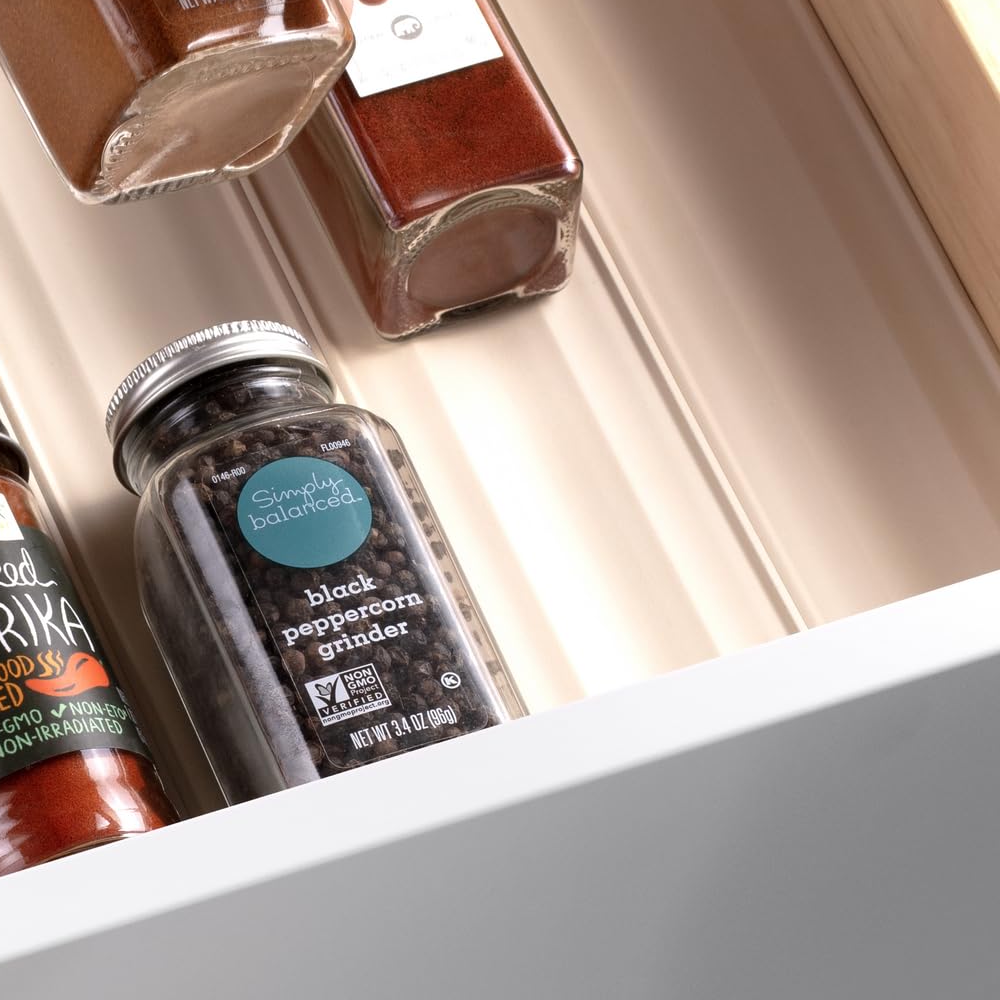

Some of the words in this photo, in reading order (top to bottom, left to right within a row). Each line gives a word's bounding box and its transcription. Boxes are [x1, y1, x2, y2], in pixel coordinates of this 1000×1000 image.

[320, 438, 351, 453] FL00946
[211, 466, 247, 484] 0146-R00
[251, 472, 344, 509] Simply
[304, 574, 377, 608] black
[281, 591, 424, 647] peppercorn
[317, 619, 410, 662] grinder
[344, 667, 373, 683] NON
[348, 676, 376, 690] GMO
[350, 684, 380, 697] Project
[321, 692, 384, 715] VERIFIED
[322, 699, 390, 724] nongmoproject.org
[350, 729, 374, 750] NET
[371, 722, 393, 742] WT
[392, 717, 412, 736] 3.4
[410, 711, 429, 731] OZ
[427, 705, 457, 728] (96g)
